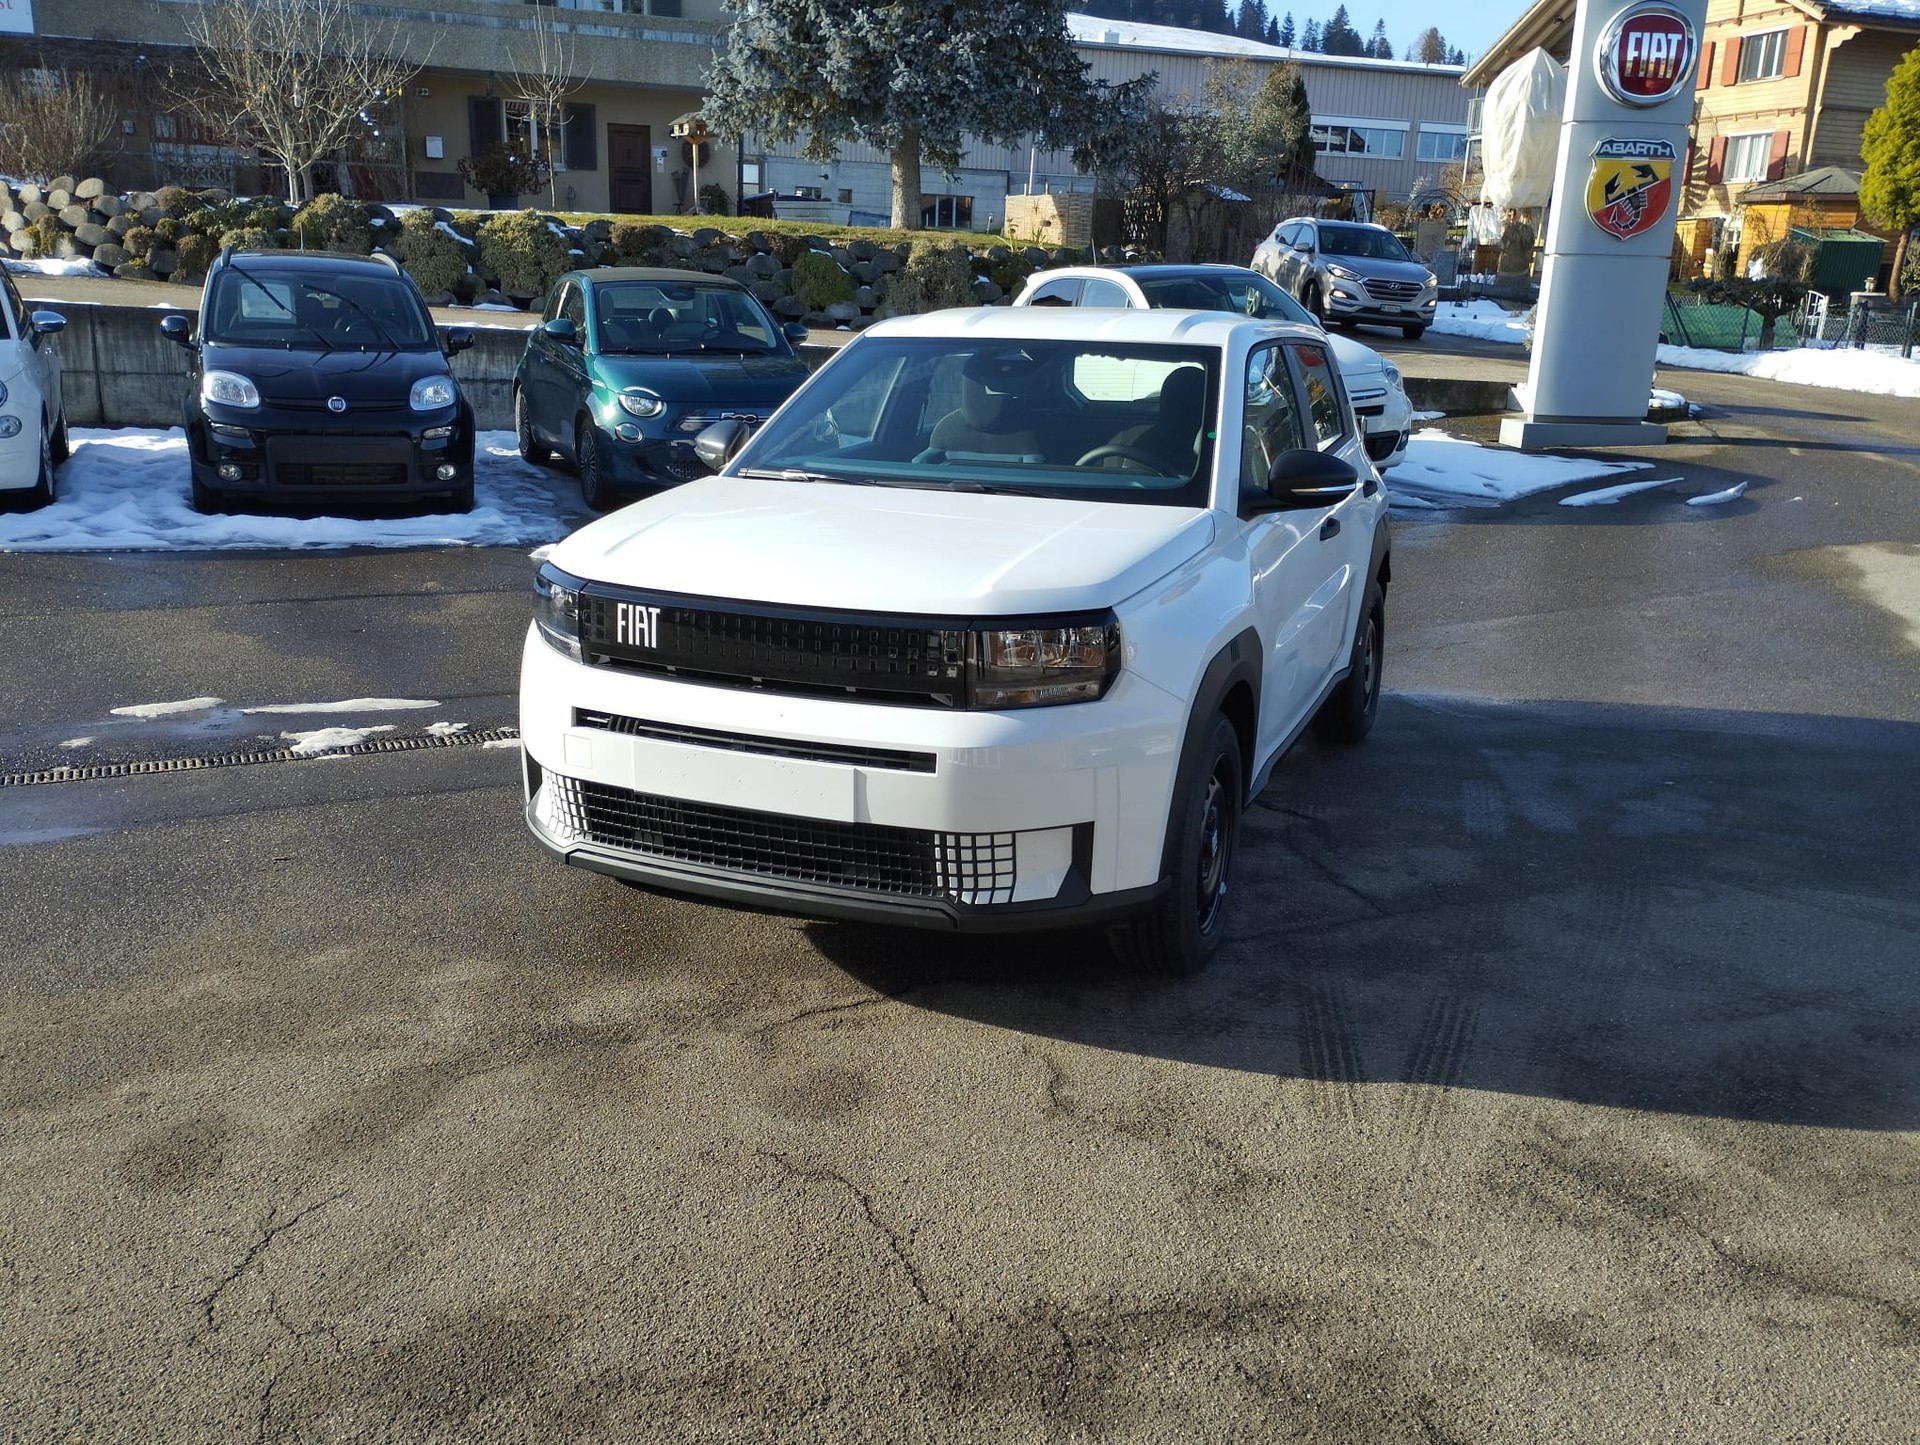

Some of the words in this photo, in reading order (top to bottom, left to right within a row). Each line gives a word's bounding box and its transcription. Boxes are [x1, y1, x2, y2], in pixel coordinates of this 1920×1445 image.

[1625, 31, 1683, 79] FIAT
[1600, 142, 1671, 156] ABARTH
[617, 603, 661, 649] FIAT
